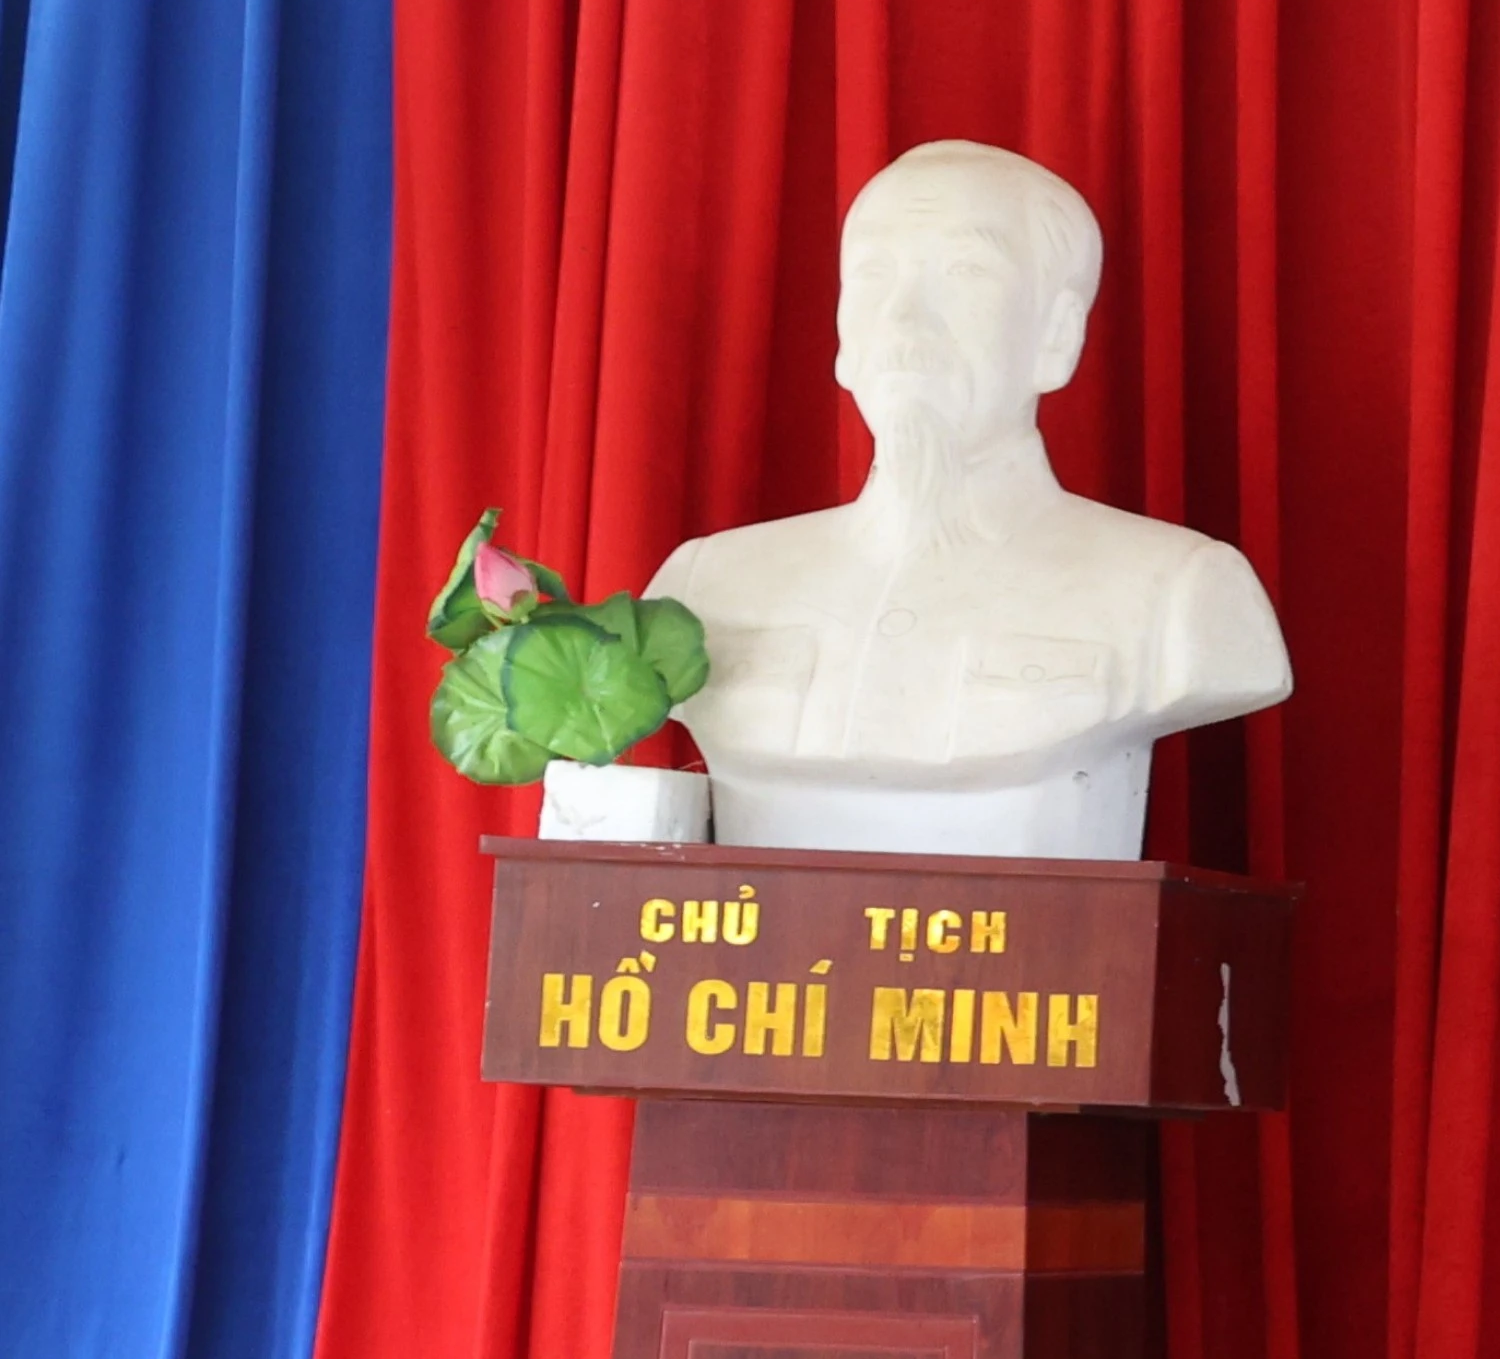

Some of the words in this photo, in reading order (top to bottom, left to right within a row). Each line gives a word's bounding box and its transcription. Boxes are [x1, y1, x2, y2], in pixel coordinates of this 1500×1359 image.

[639, 884, 760, 946] CHỦ
[863, 906, 1008, 964] TỊCH
[538, 949, 657, 1053] HỒ
[685, 959, 834, 1059] CHÍ
[868, 986, 1100, 1069] MINH
